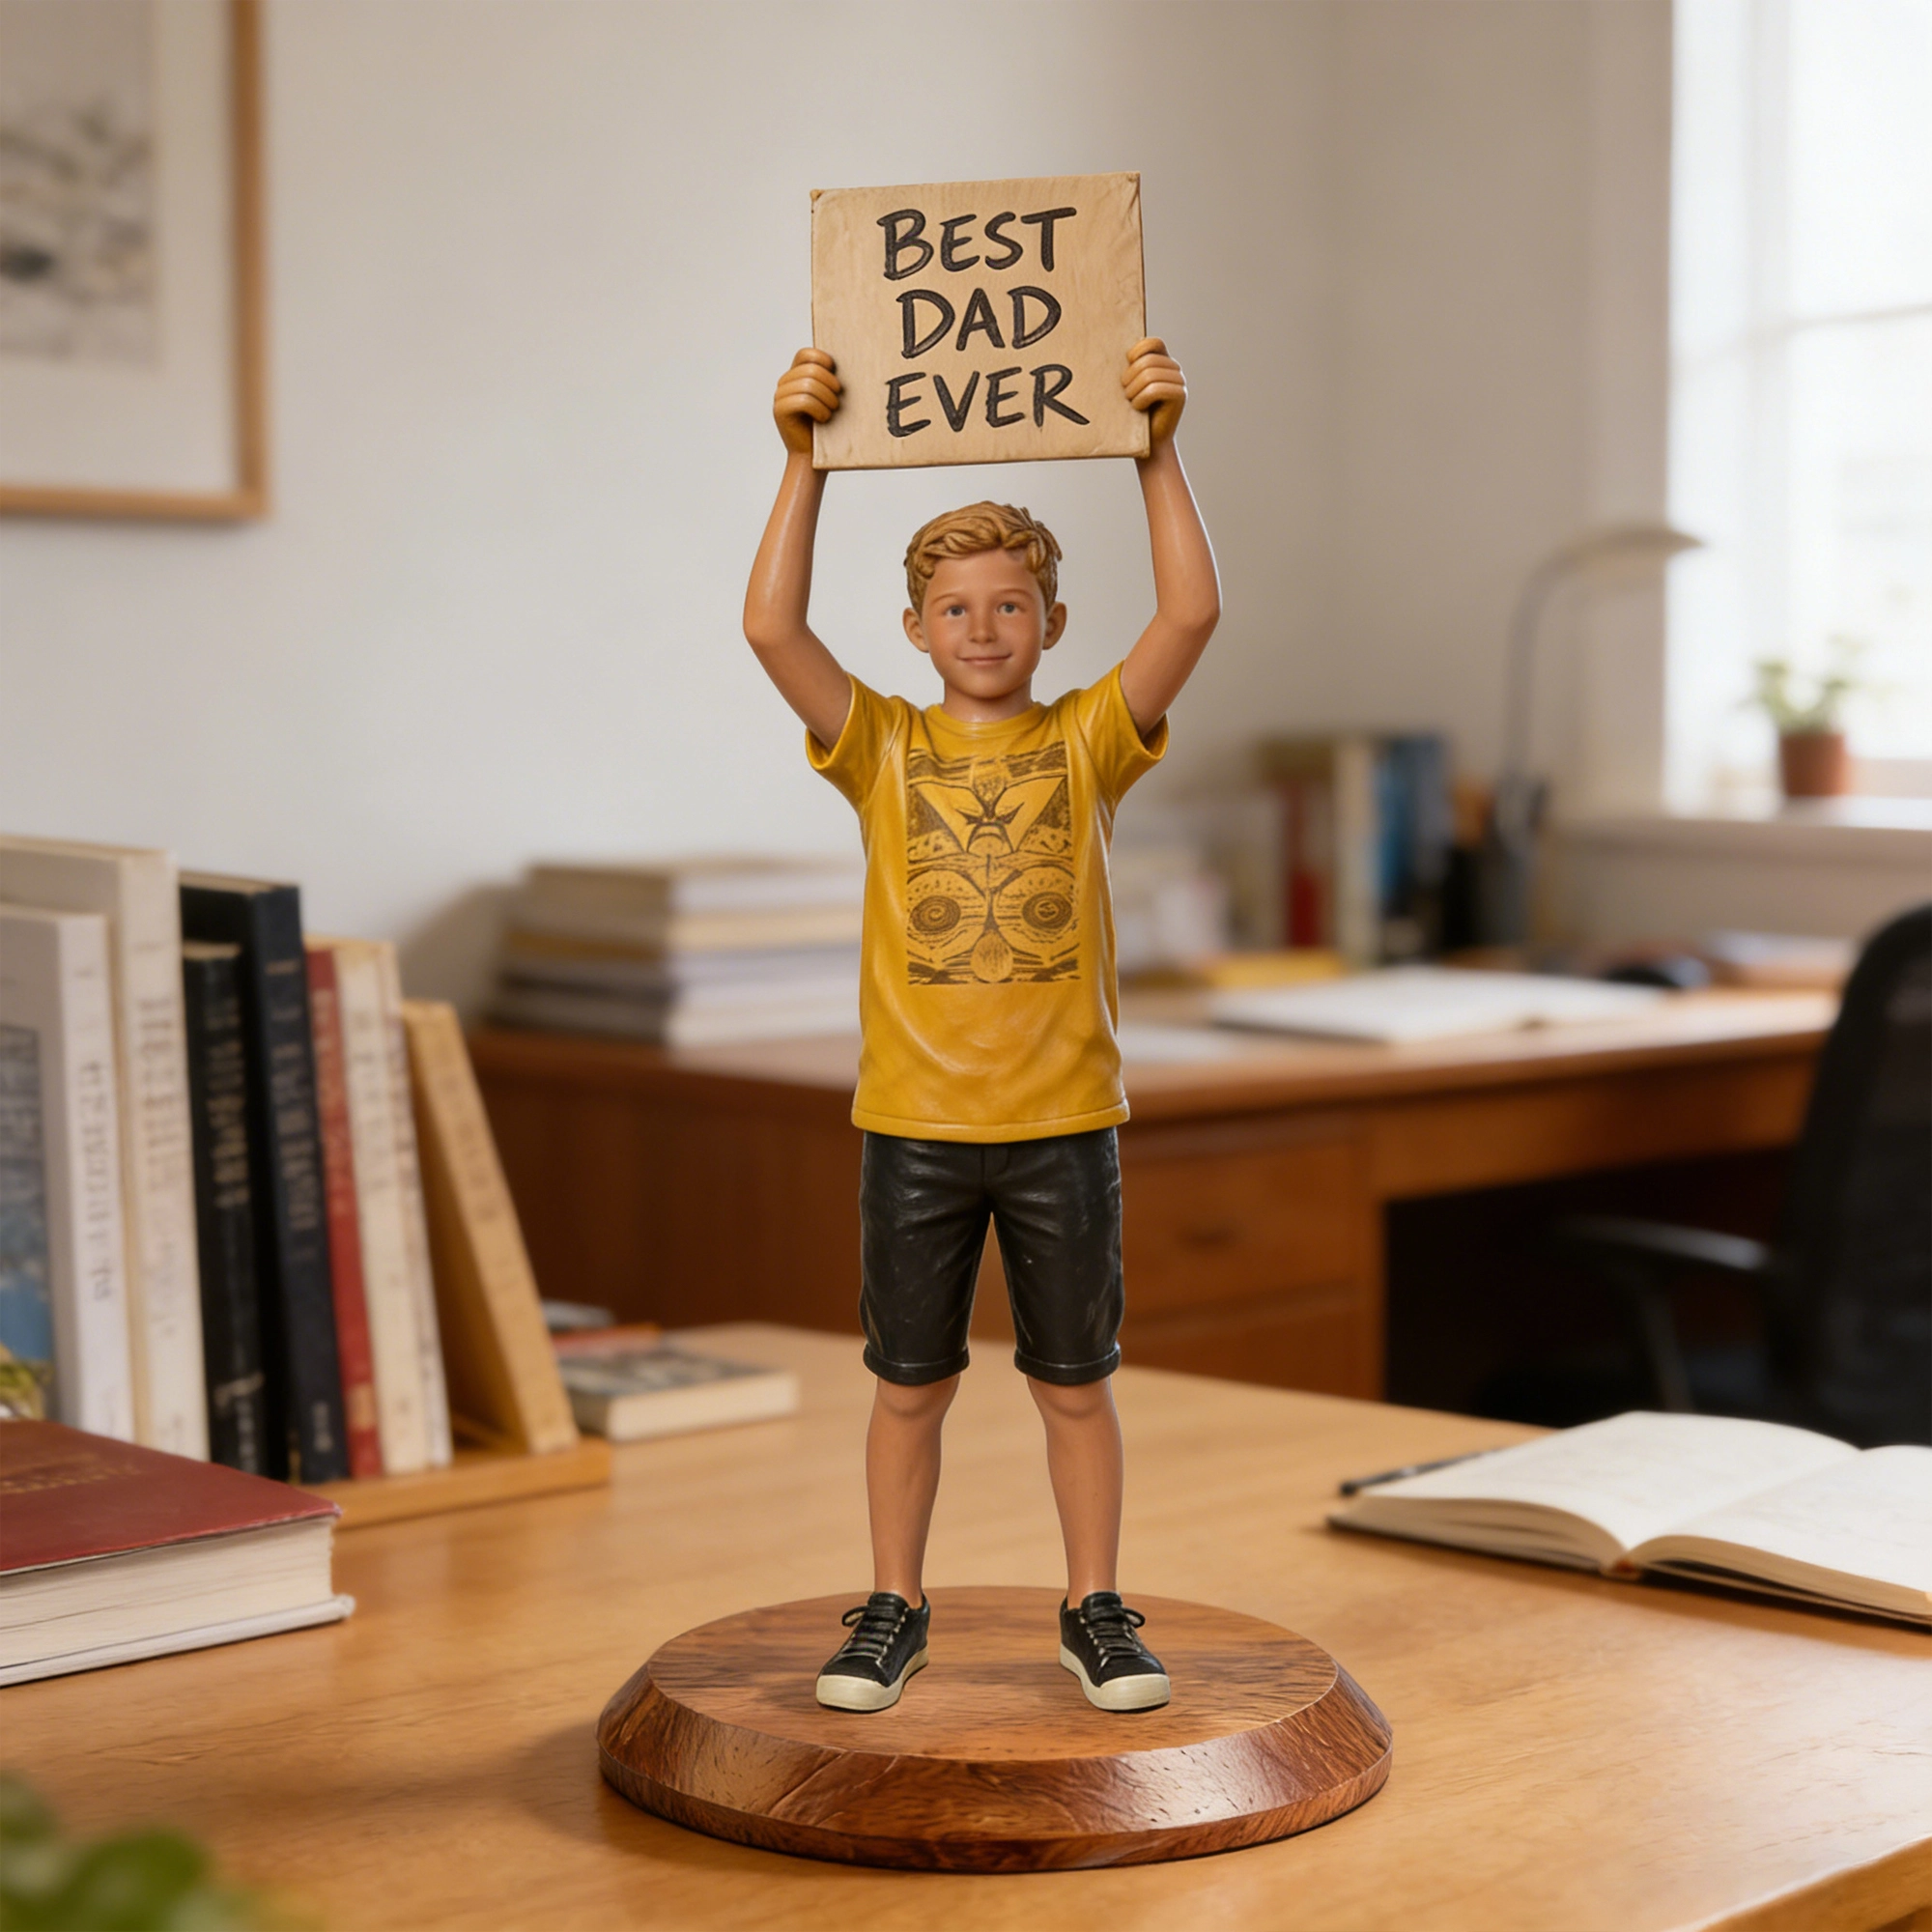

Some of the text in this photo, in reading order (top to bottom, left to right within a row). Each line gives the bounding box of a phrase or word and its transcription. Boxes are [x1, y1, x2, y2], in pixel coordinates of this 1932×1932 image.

[876, 207, 1077, 281] BEST
[895, 285, 1062, 359] DAD
[885, 363, 1091, 438] EVER
